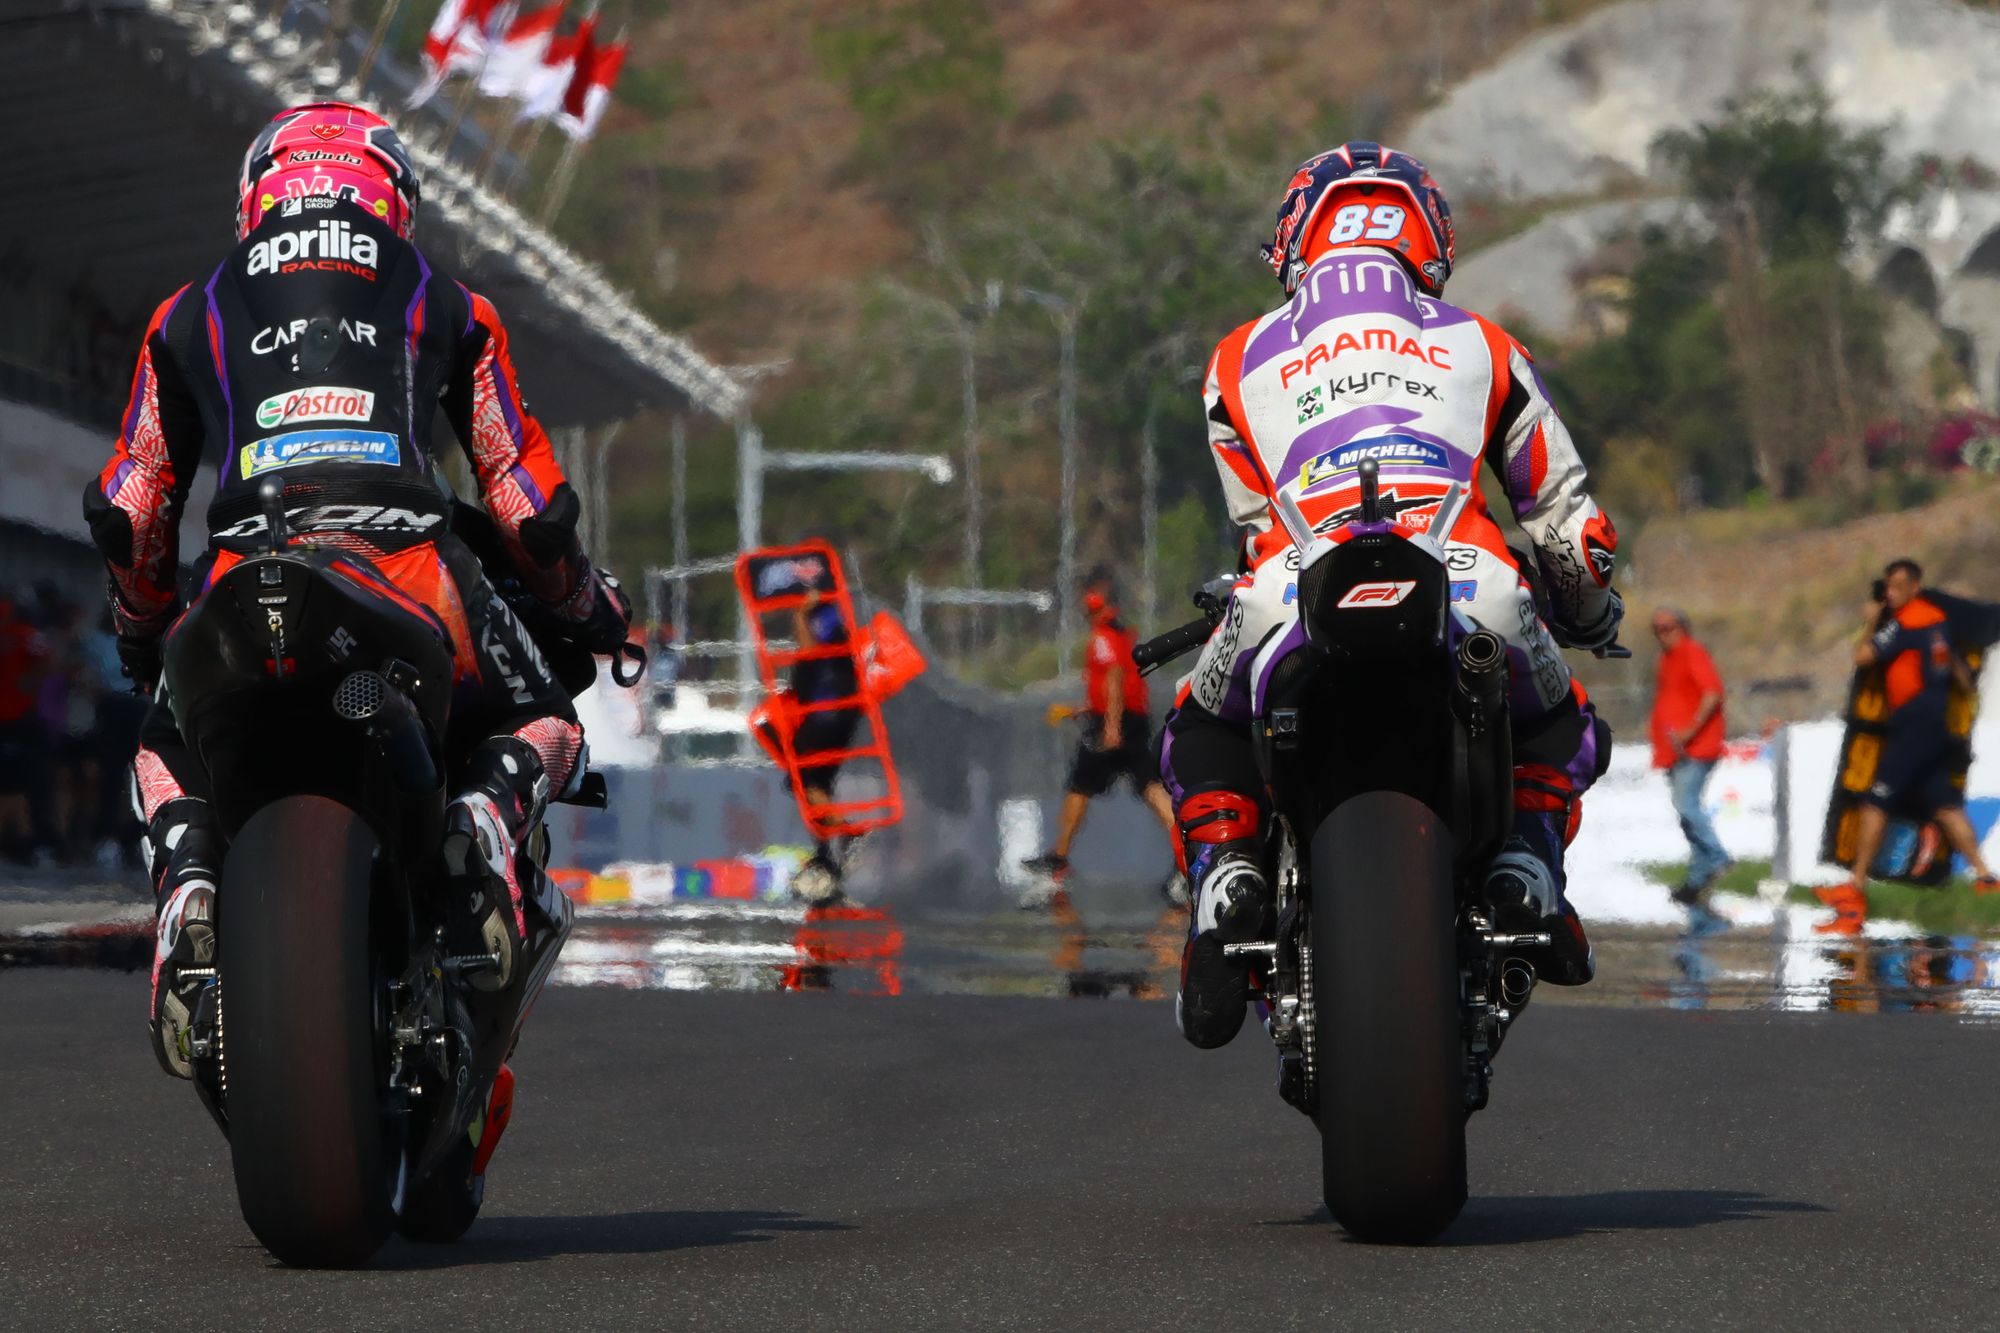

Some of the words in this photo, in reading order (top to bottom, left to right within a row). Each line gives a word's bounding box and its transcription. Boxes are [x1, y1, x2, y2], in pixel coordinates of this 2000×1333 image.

[304, 197, 338, 205] PIAGGIO
[1328, 204, 1407, 245] 89
[247, 219, 379, 276] aprilia
[281, 260, 377, 283] RACING
[1280, 328, 1452, 390] PRAMAC
[284, 391, 367, 418] Castrol
[280, 440, 387, 458] MICHELIN
